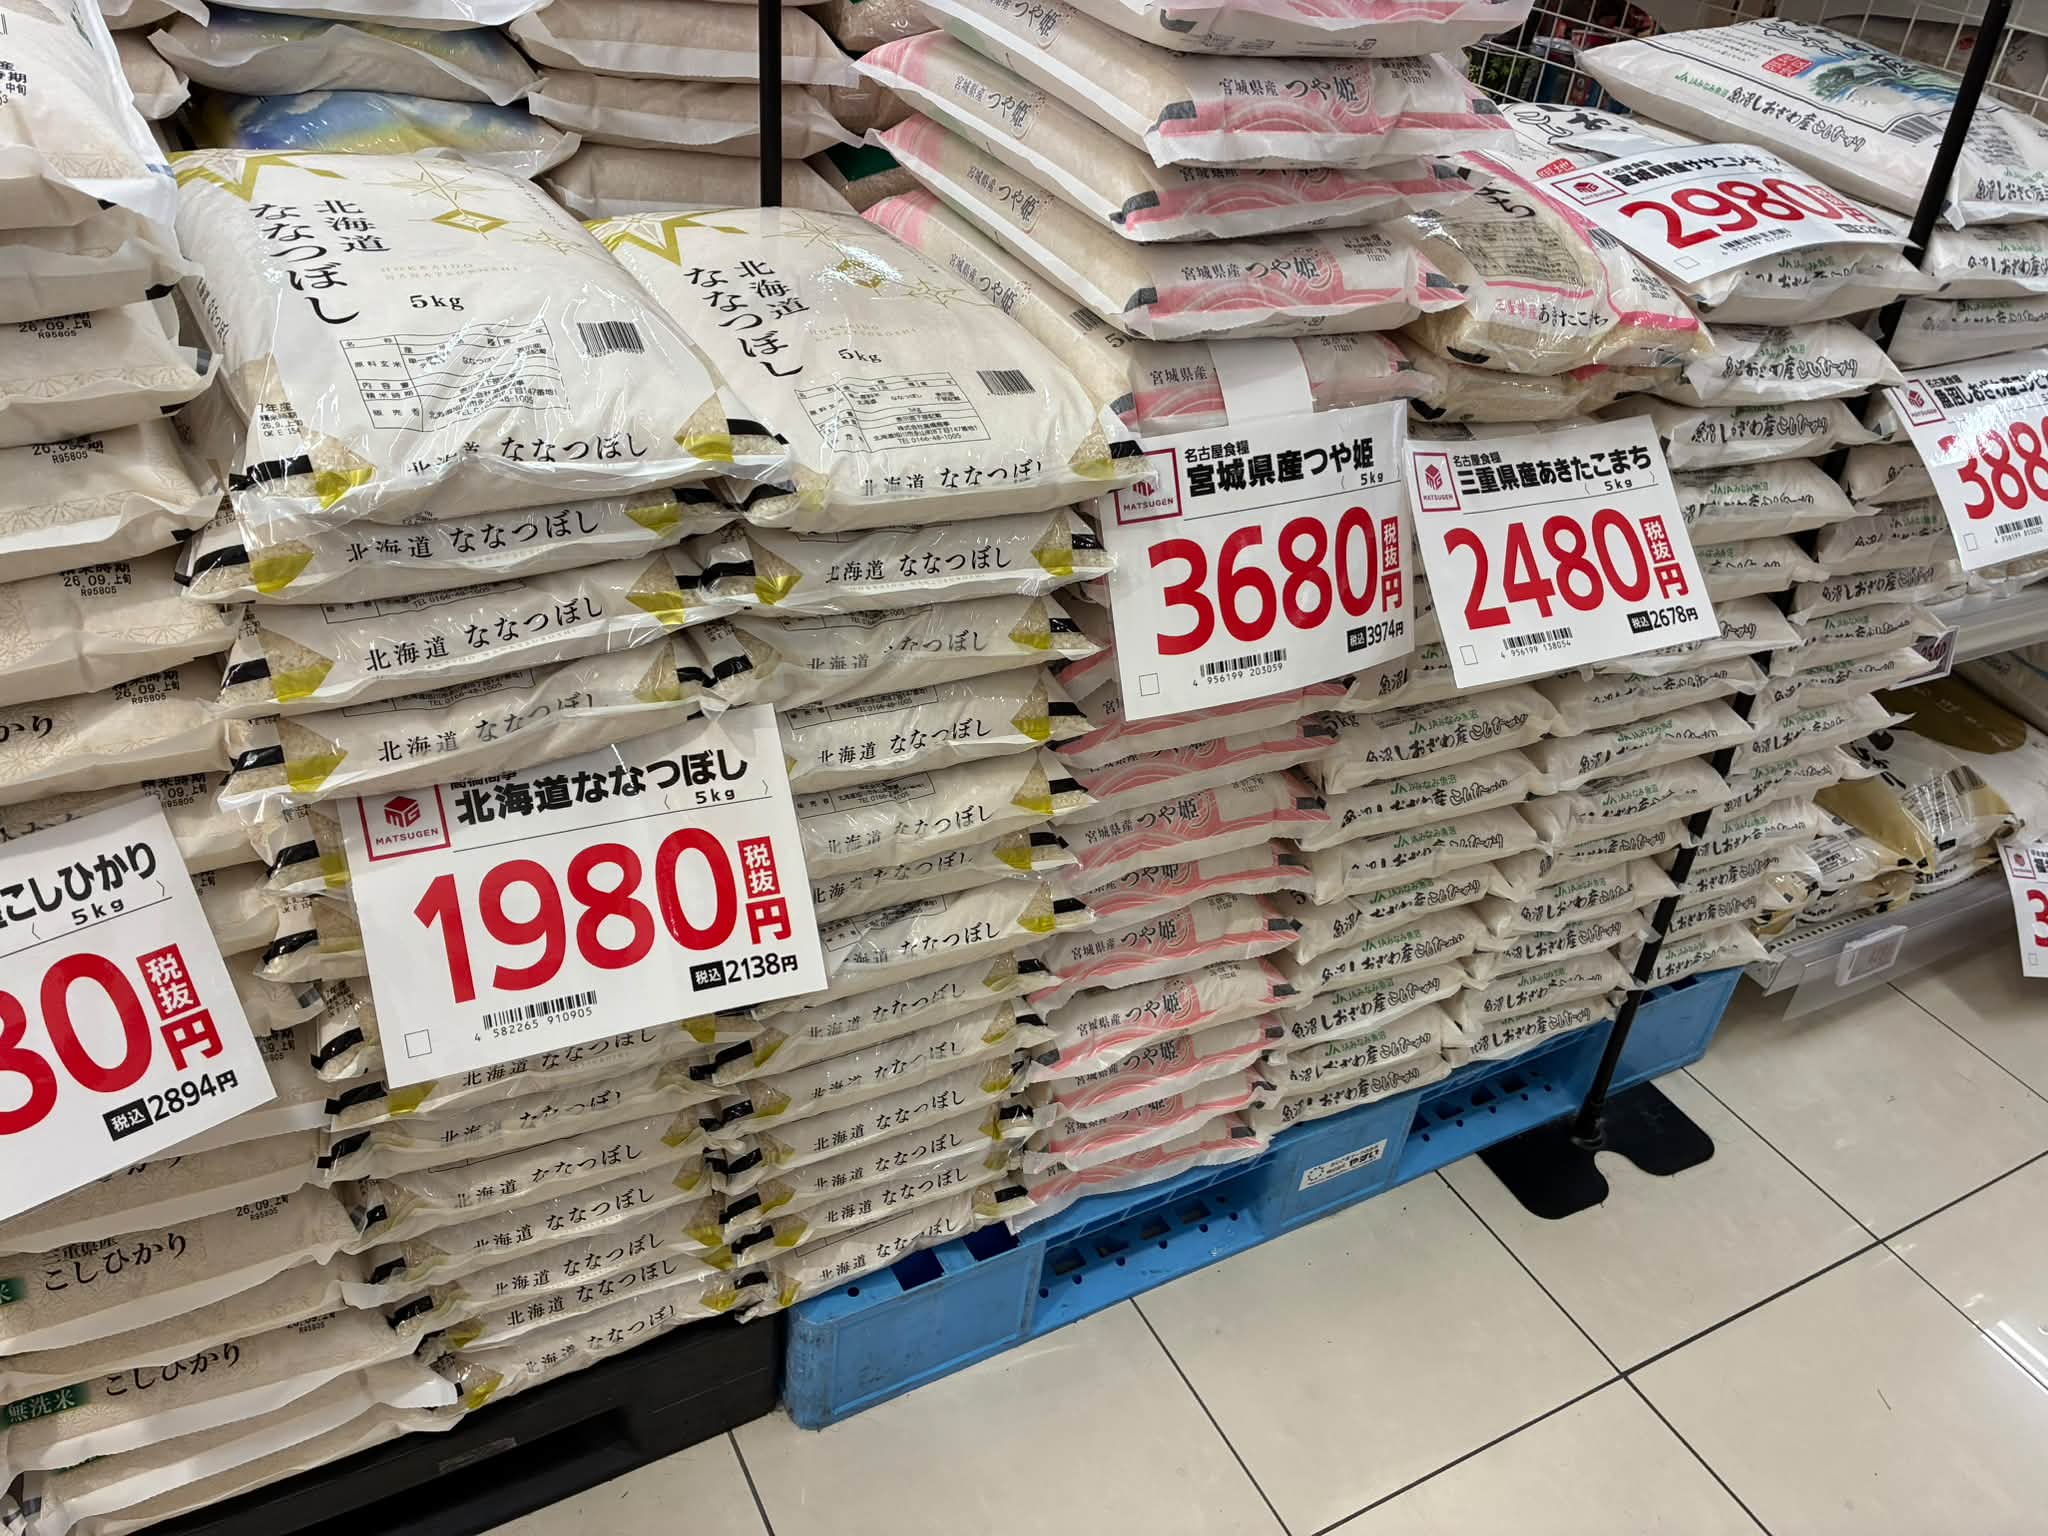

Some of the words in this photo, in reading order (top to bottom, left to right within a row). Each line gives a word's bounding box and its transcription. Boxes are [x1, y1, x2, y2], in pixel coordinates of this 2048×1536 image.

[1219, 78, 1280, 97] 宮城県産
[1286, 76, 1360, 103] つや姫
[314, 200, 391, 253] 北海道
[1618, 178, 1844, 249] 2980
[249, 203, 360, 325] ななつぼし
[1182, 264, 1241, 281] 宮城県産
[1245, 256, 1319, 280] つや姫
[410, 294, 465, 312] 5kg
[733, 259, 810, 320] 北海道
[683, 267, 804, 378] ななつぼし
[838, 348, 882, 364] 5kg
[1150, 366, 1208, 385] 宮城県産
[501, 433, 648, 462] ななつぼし
[1184, 440, 1250, 463] 名古屋食糧
[1186, 437, 1375, 498] 宮城県産つや姫
[1937, 416, 2048, 521] 388
[1360, 472, 1384, 487] 5kg
[1458, 445, 1652, 496] 三重県産あきたこまち
[1604, 478, 1633, 492] 5kg
[1123, 497, 1175, 512] MATSUGEN
[1423, 493, 1454, 501] MATSUGEN
[346, 536, 434, 563] 北海道
[448, 510, 600, 554] ななつぼし
[1382, 521, 1399, 568] 税抜
[1643, 519, 1672, 560] 税抜
[63, 574, 132, 588] 26.09.上旬
[899, 546, 1013, 577] ななつぼし
[1148, 506, 1378, 656] 3680
[1443, 508, 1651, 631] 2480
[1654, 563, 1690, 600] 円
[1381, 571, 1402, 613] 円
[364, 635, 449, 672] 北海道
[463, 595, 604, 648] ななつぼし
[1366, 621, 1404, 647] 3974円
[1650, 605, 1699, 630] 2678円
[1207, 670, 1244, 685] 956199
[1250, 662, 1284, 677] 203059
[1510, 645, 1539, 658] 956199
[377, 731, 458, 763] 北海道
[817, 743, 877, 765] 北海道
[889, 719, 993, 753] ななつぼし
[455, 749, 749, 826] 北海道ななつぼし
[695, 787, 736, 806] 5kg
[375, 826, 439, 846] MATSUGEN
[1085, 820, 1134, 844] 宮城県産
[1137, 797, 1200, 829] つや姫
[0, 842, 157, 928] こしひかり
[742, 841, 777, 896] 税抜
[71, 898, 126, 926] 5kg
[413, 827, 738, 1004] 1980
[745, 897, 793, 944] 円
[1071, 938, 1116, 960] 宮城県産
[1121, 919, 1177, 947] つや姫
[146, 952, 195, 1015] 税抜
[694, 966, 722, 986] 税込
[725, 952, 799, 985] 2138円
[493, 1016, 540, 1039] 582265
[547, 1005, 594, 1026] 910905
[1077, 1013, 1121, 1037] 宮城県産
[1125, 992, 1182, 1020] つや姫
[160, 1008, 224, 1072] 円
[1123, 1039, 1178, 1069] つや姫
[462, 1058, 530, 1087] 北海道
[148, 1069, 239, 1121] 2894円
[813, 1123, 865, 1152] 北海道
[875, 1089, 967, 1130] ななつぼし
[454, 1179, 518, 1209] 北海道
[531, 1143, 642, 1183] ななつぼし
[814, 1166, 864, 1191] 北海道
[875, 1133, 964, 1172] ななつぼし
[545, 1187, 656, 1231] ななつぼし
[825, 1199, 873, 1223] 北海道
[882, 1167, 969, 1206] ななつぼし
[45, 1232, 187, 1291] こしひかり
[494, 1268, 551, 1297] 北海道
[563, 1232, 665, 1277] ななつぼし
[818, 1253, 867, 1281] 北海道
[507, 1296, 565, 1327] 北海道
[575, 1258, 679, 1303] ななつぼし
[106, 1342, 241, 1397] こしひかり
[8, 1389, 76, 1423] 無洗米
